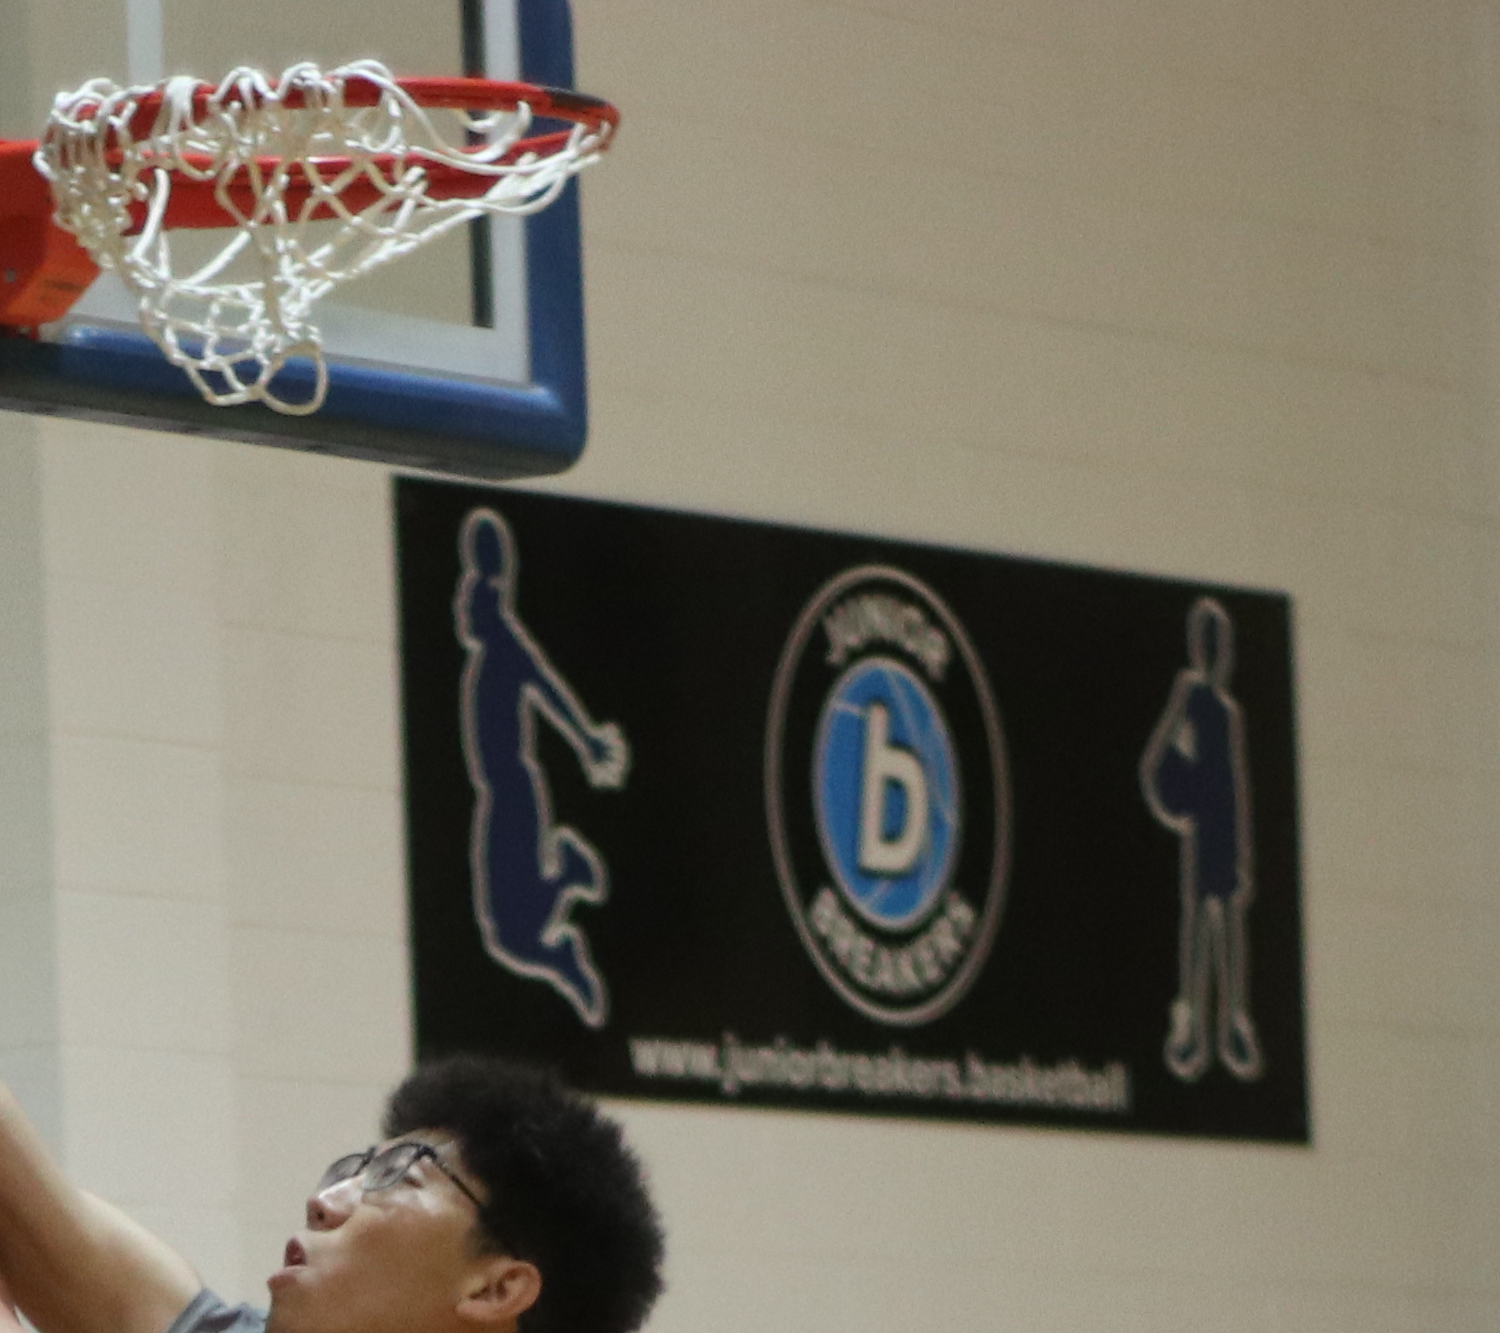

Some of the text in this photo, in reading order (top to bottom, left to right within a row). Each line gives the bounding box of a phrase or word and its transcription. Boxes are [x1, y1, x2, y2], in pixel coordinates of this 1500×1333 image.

[822, 594, 951, 683] JUNIOR
[858, 701, 929, 871] b
[809, 886, 977, 995] BREAKERS
